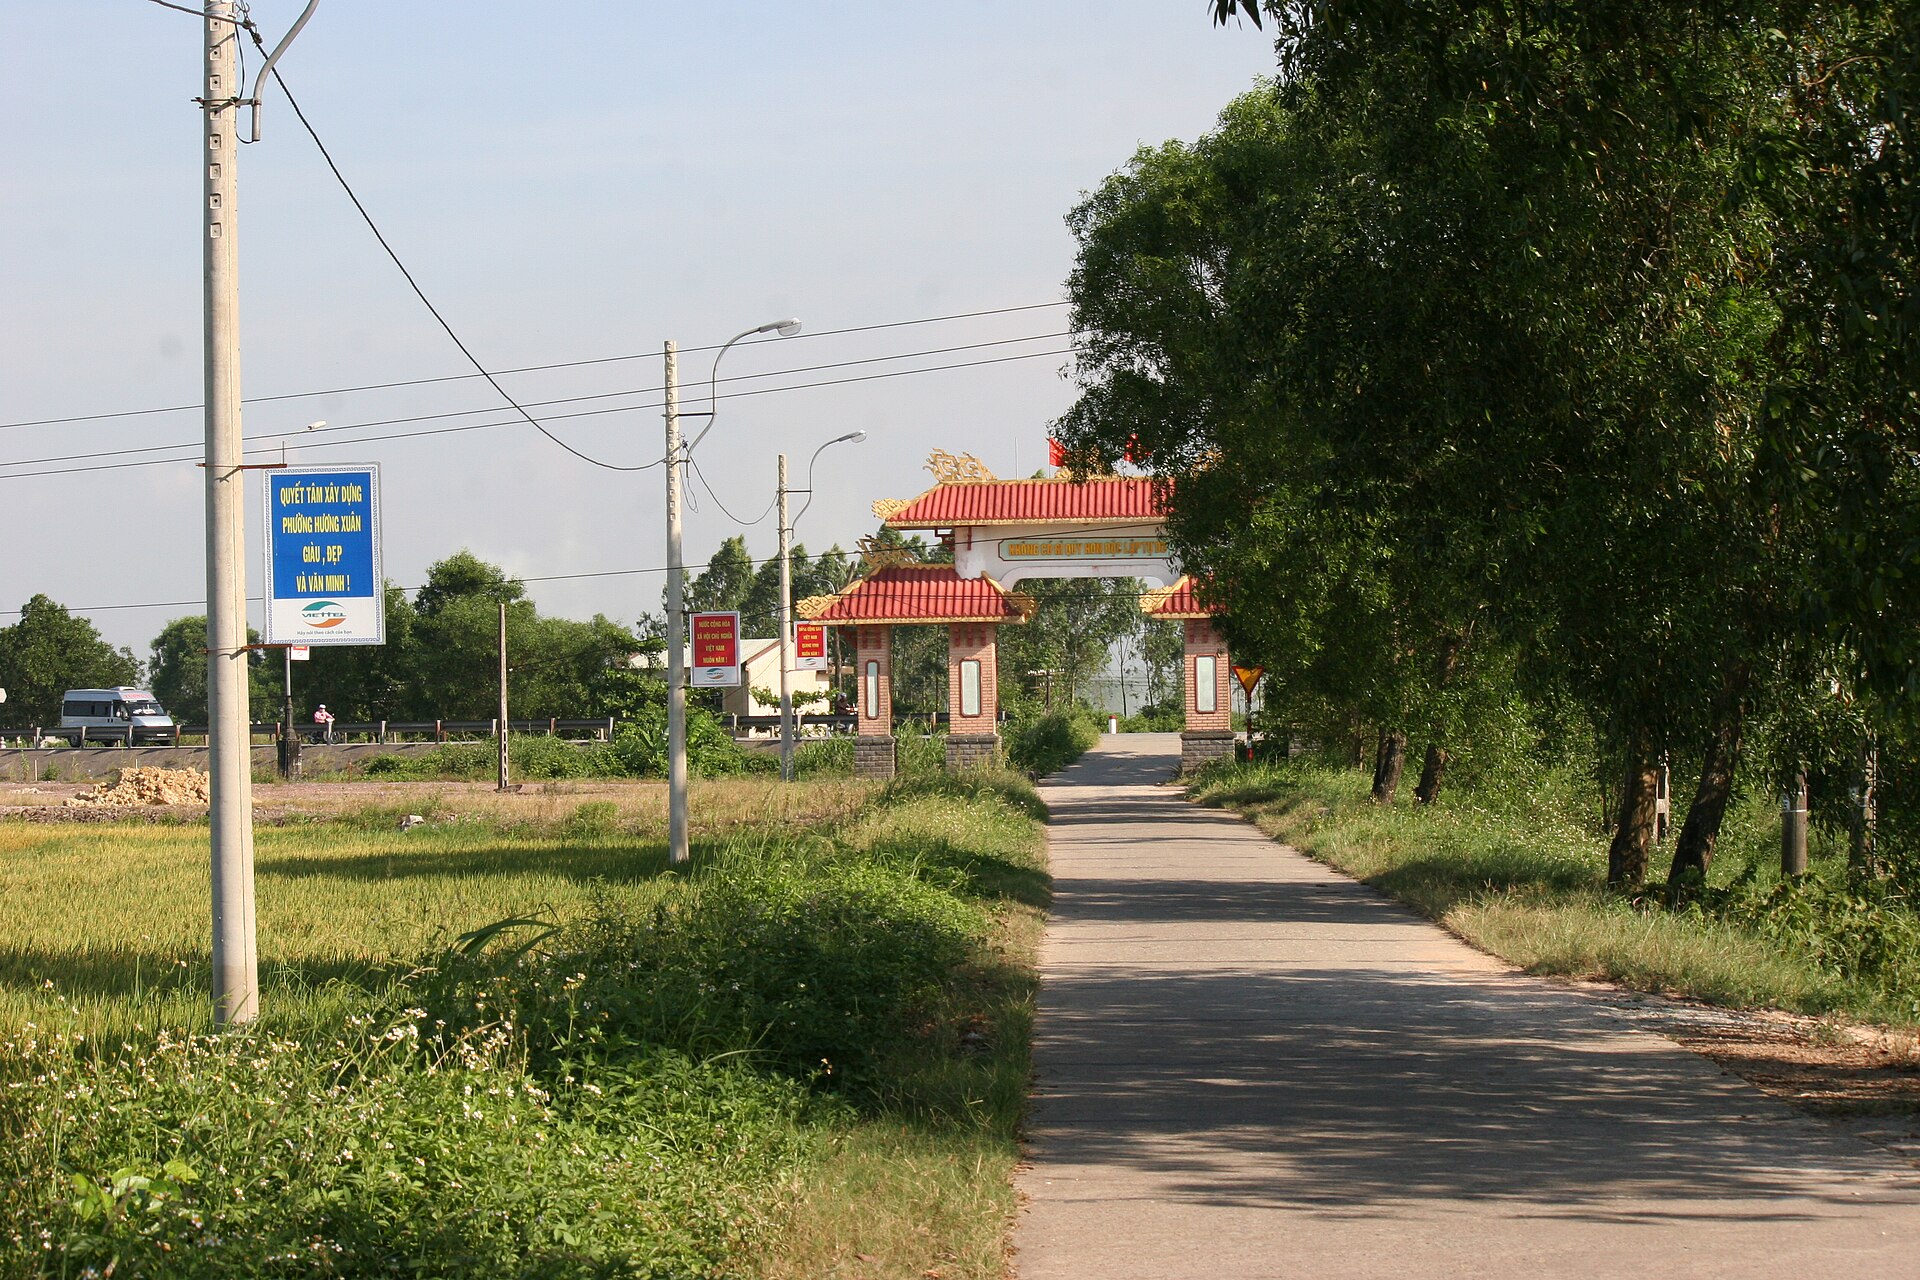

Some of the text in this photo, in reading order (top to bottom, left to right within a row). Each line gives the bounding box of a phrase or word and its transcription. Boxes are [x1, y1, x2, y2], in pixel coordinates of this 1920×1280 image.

[280, 481, 362, 507] QUYẾT TÂM XÂY DỰNG
[282, 511, 361, 534] PHƯỜNG HƯƠNG XUÂN
[303, 542, 320, 563] GIÀU
[326, 545, 343, 567] ĐẸP
[296, 572, 307, 593] VÀ
[309, 573, 324, 592] VĂN
[326, 574, 345, 592] MINH
